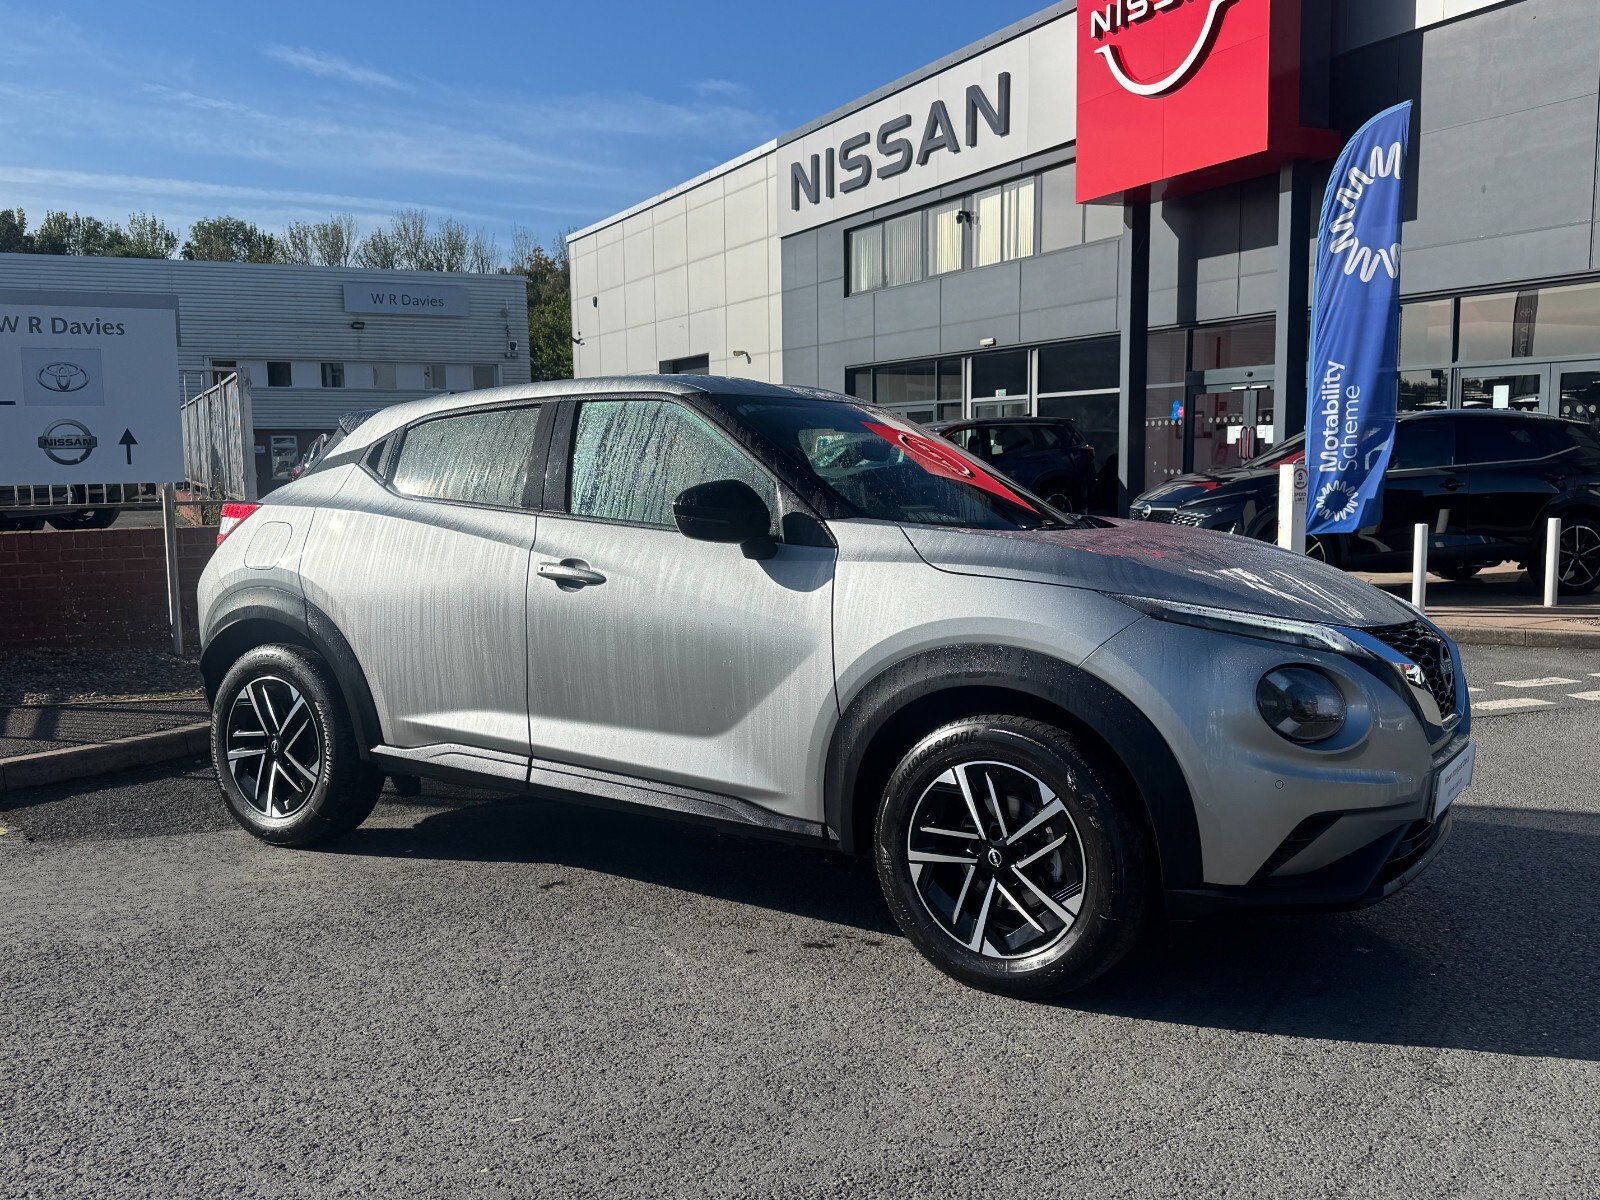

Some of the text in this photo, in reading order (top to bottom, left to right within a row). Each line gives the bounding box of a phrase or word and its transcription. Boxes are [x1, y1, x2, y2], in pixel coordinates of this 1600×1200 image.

[791, 71, 1011, 211] NISSAN
[370, 293, 445, 307] W R Davies
[28, 316, 43, 334] R
[51, 316, 125, 336] Davies
[1319, 360, 1345, 472] Motability
[1338, 385, 1361, 471] Scheme
[43, 438, 92, 446] NISSAN
[1298, 472, 1303, 481] 5
